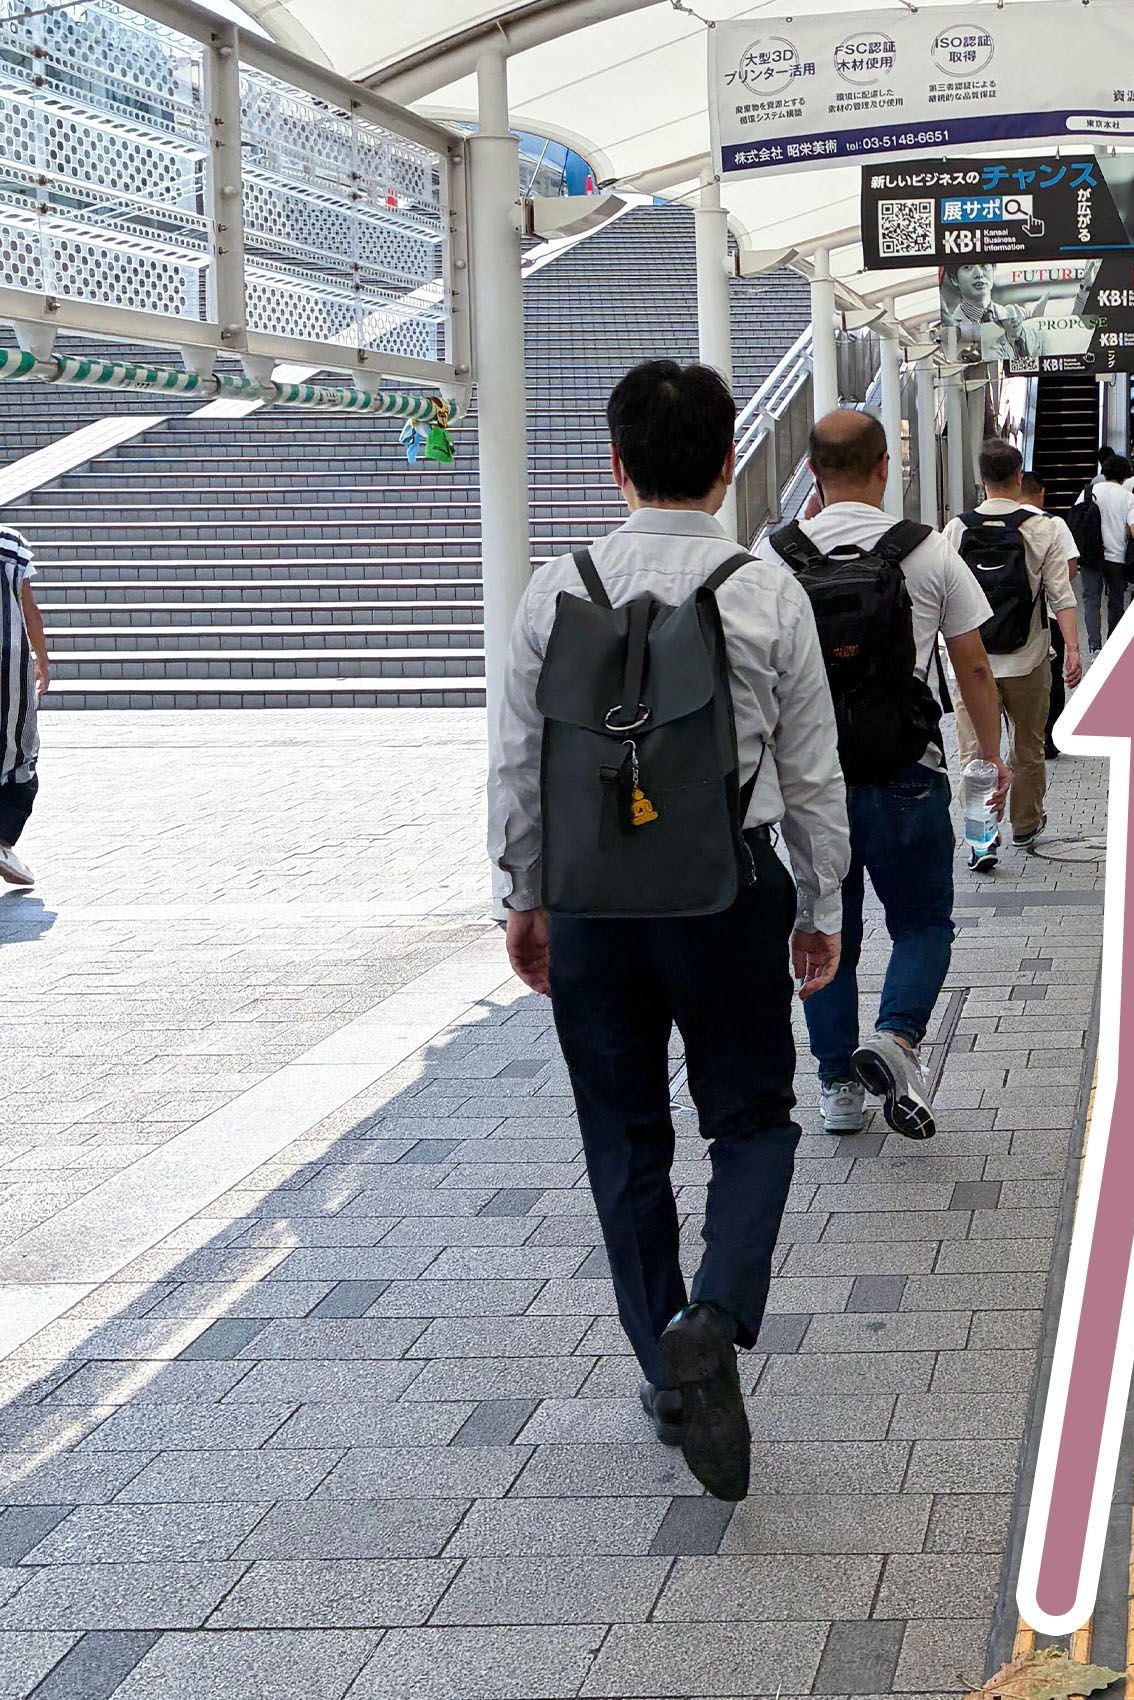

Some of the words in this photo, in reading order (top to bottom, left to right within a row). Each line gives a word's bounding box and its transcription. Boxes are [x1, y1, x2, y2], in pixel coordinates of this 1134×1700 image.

[834, 40, 897, 57] FSC認証
[935, 35, 992, 49] ISO認証
[745, 48, 794, 67] 大型3D
[837, 56, 894, 72] 木材使用
[949, 49, 977, 63] 取得
[724, 62, 816, 86] プリンター活用
[1086, 119, 1121, 130] 東京本社
[734, 147, 784, 166] 株式会社
[787, 140, 838, 159] 昭栄美術
[943, 198, 1001, 221] 展サポ
[1076, 188, 1093, 243] が広がる
[983, 228, 1009, 237] Kansai
[942, 229, 981, 254] KBI
[1012, 268, 1086, 283] FUTURE
[1098, 289, 1128, 307] KBI
[1099, 333, 1124, 347] KBI
[1042, 358, 1064, 372] KBI
